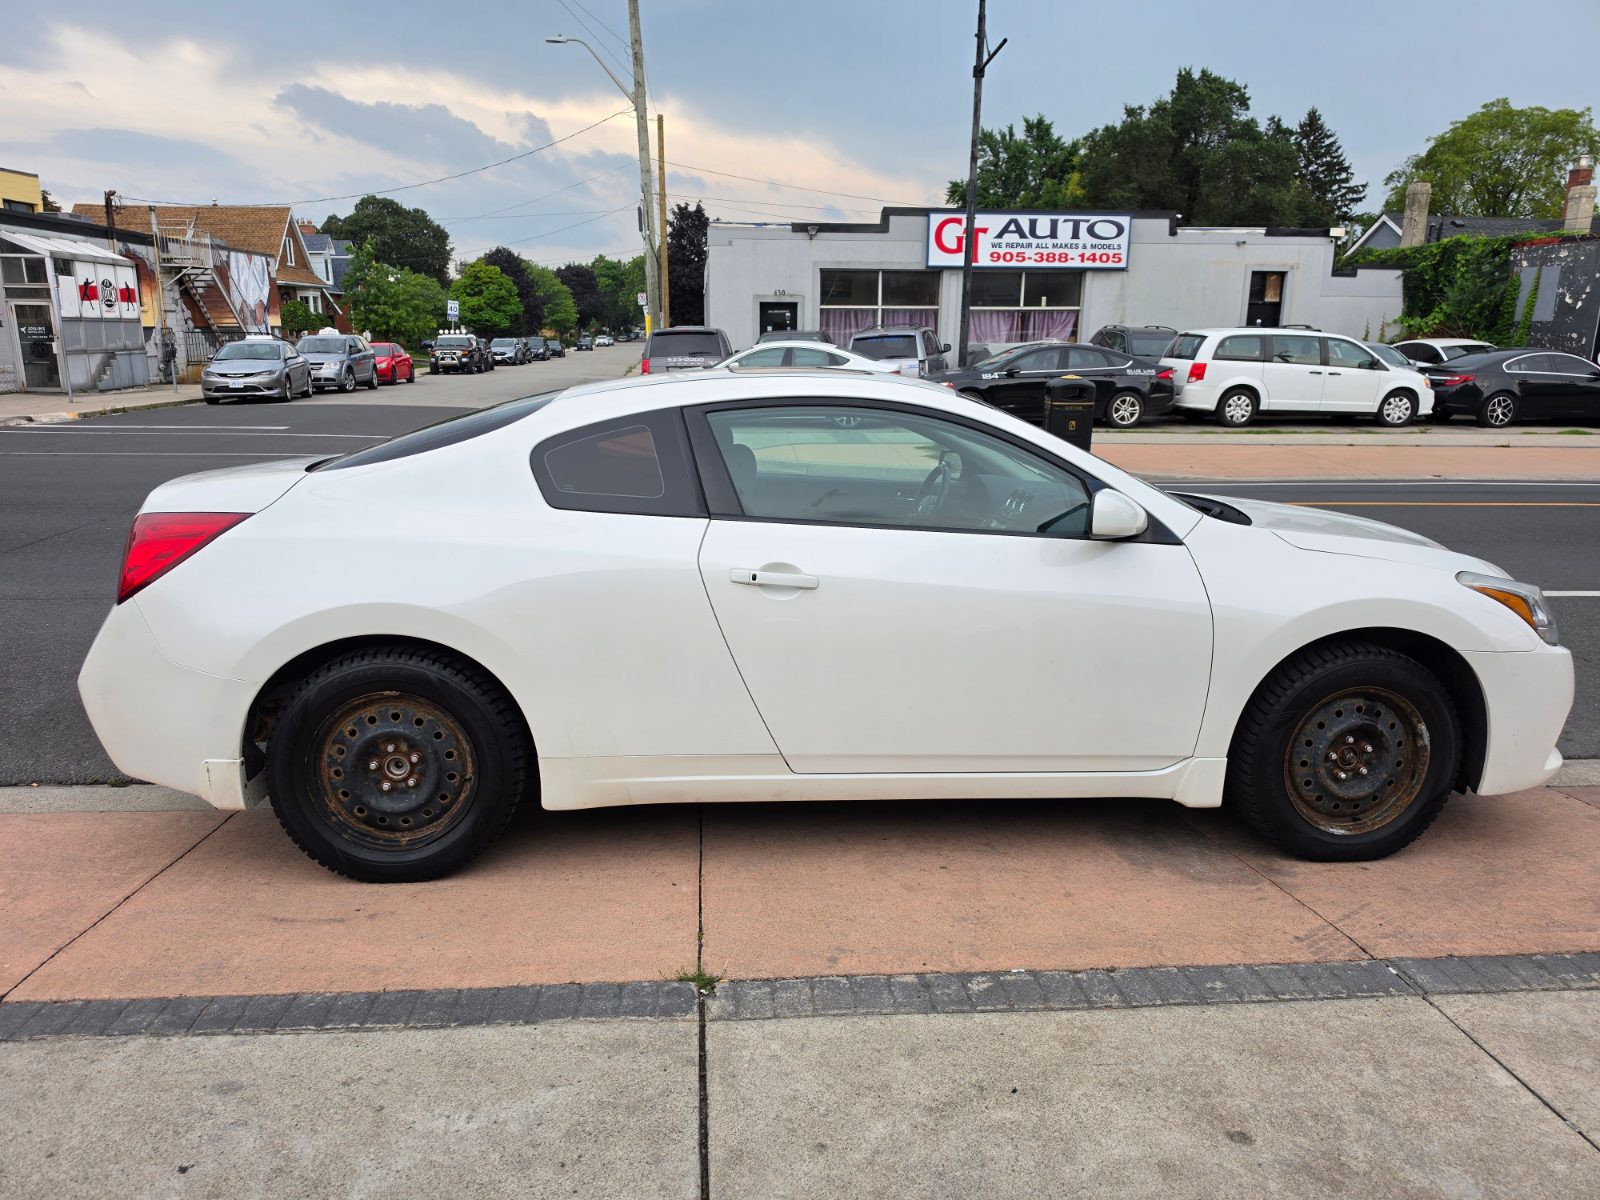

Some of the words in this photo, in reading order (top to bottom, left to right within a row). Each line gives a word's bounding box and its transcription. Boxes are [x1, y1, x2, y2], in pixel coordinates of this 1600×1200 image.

[934, 217, 989, 263] GT
[994, 217, 1125, 240] AUTO
[1052, 242, 1079, 250] MAKES
[990, 251, 1123, 264] 905-388-1405
